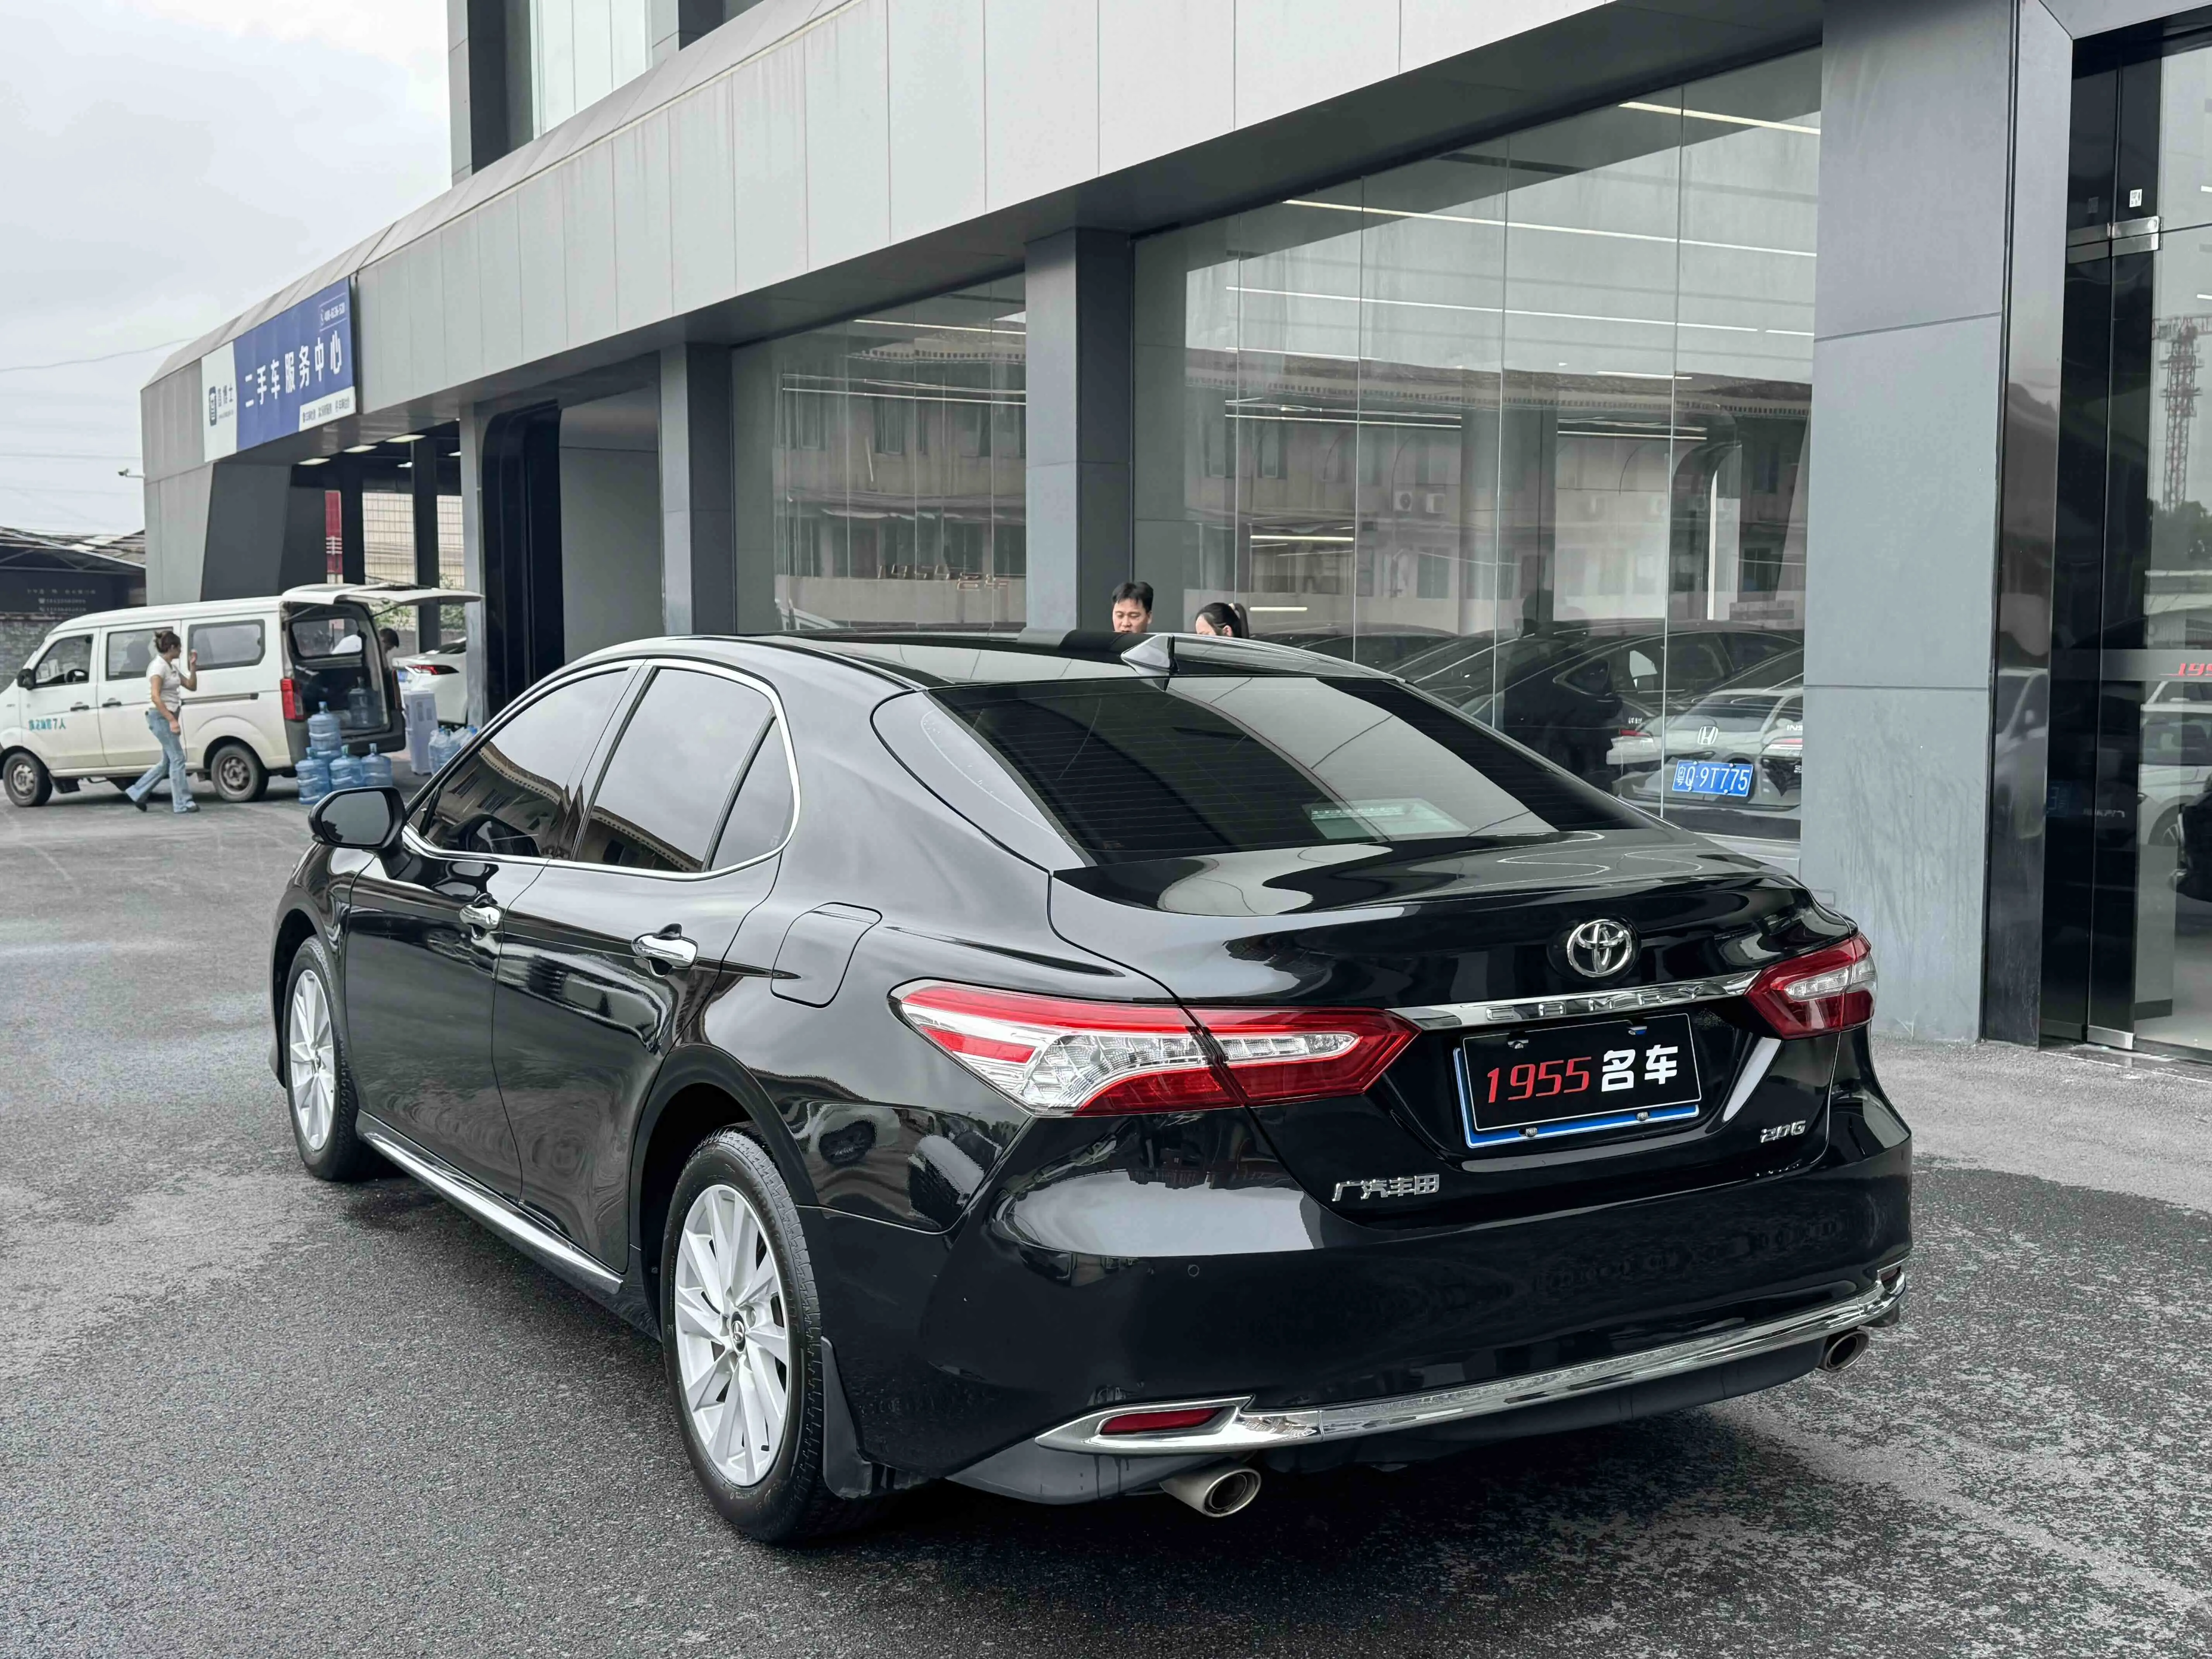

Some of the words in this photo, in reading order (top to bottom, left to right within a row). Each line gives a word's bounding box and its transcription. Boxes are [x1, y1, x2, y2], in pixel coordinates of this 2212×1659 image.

[245, 330, 342, 408] 二手车服务中心
[1332, 1174, 1439, 1201] 广汽丰田
